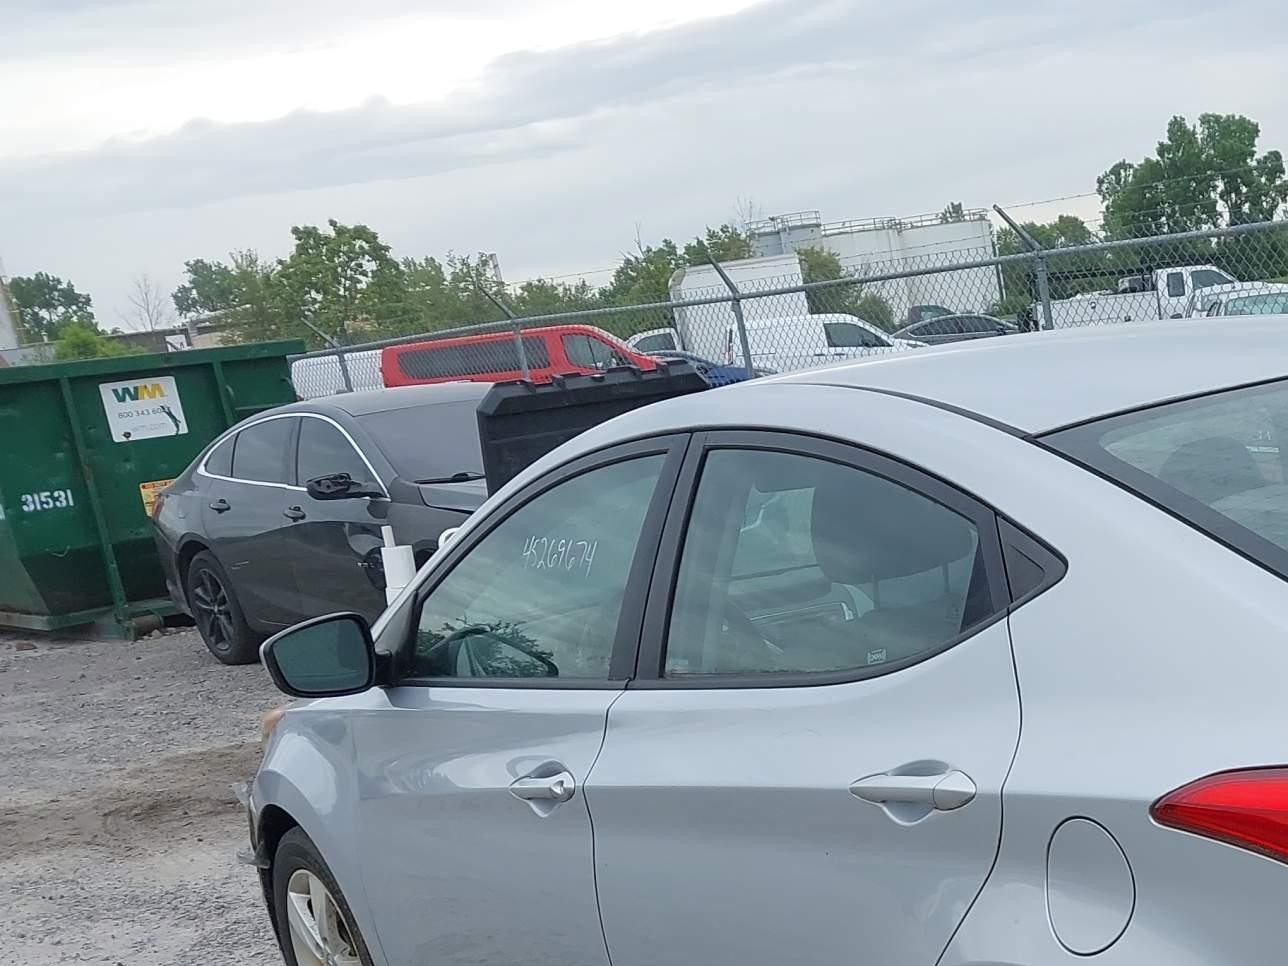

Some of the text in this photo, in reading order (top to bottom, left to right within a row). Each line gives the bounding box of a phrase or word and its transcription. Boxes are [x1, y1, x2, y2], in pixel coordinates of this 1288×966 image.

[112, 384, 168, 403] WM
[21, 489, 74, 512] 31531
[523, 536, 597, 577] 45269674
